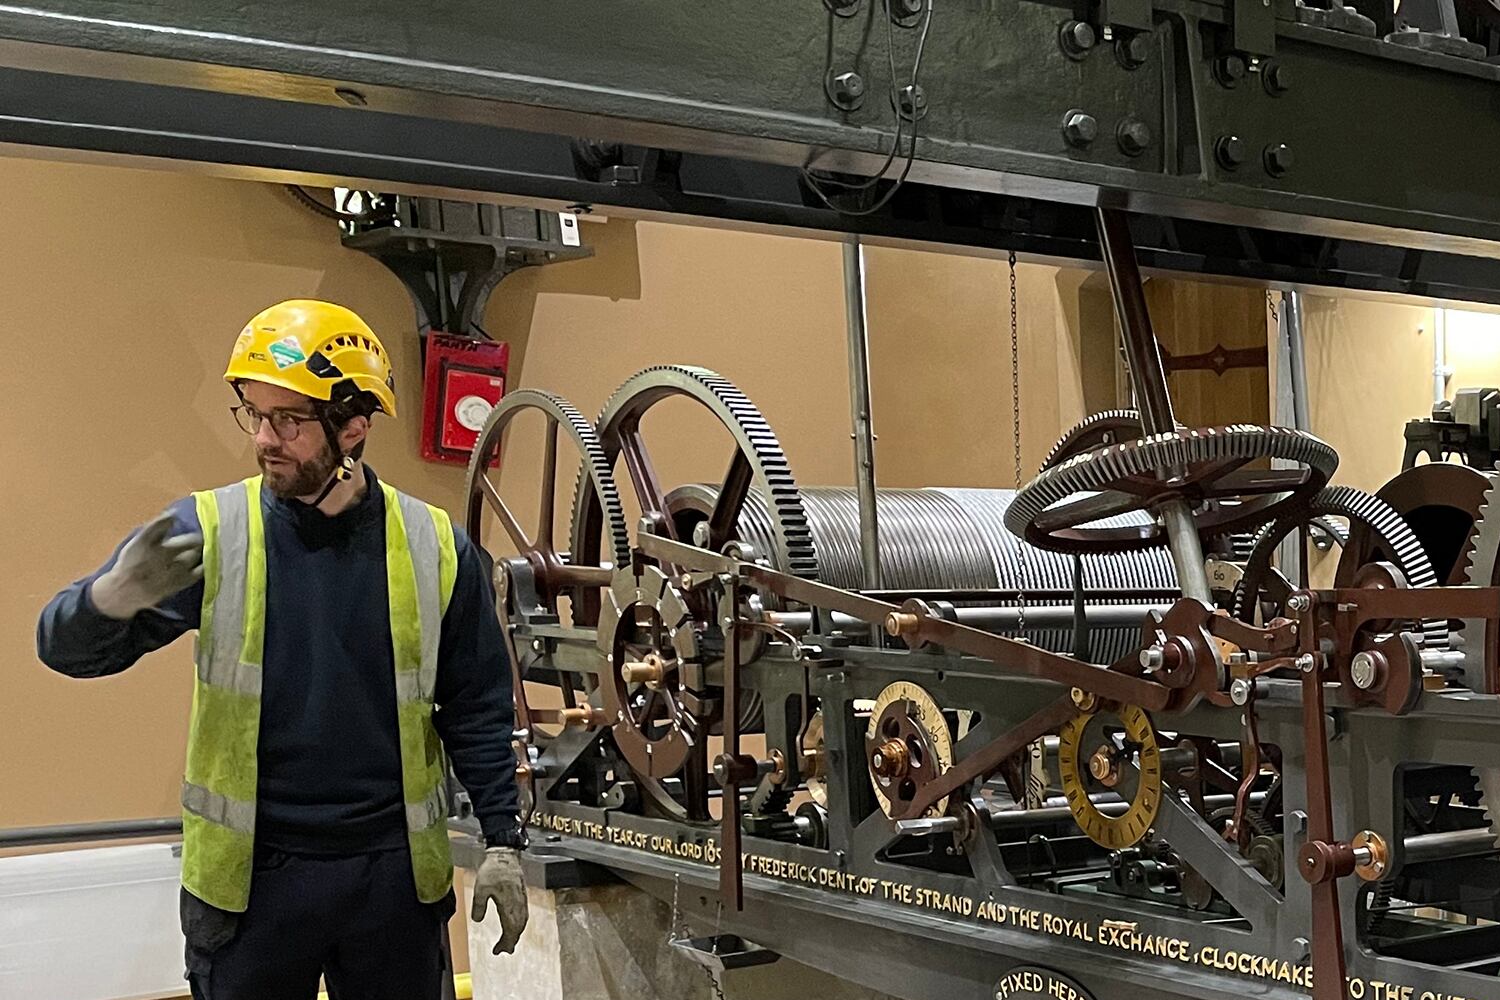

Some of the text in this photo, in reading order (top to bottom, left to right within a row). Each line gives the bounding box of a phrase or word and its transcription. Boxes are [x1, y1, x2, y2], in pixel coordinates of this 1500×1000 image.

[543, 813, 572, 832] MADE
[572, 819, 583, 835] IN
[584, 821, 604, 839] THE
[606, 826, 634, 846] YEAR
[634, 833, 648, 849] OF
[651, 835, 673, 854] OUR
[675, 842, 702, 859] LORD
[750, 855, 817, 883] FREDERICK
[859, 876, 879, 895] OF
[881, 880, 912, 904] THE
[915, 887, 973, 916] STRAND
[976, 901, 1007, 923] AND
[1008, 906, 1041, 931] THE
[1043, 913, 1093, 942] ROYAL
[1200, 946, 1314, 988] CLOCKMAKE
[1345, 976, 1365, 999] O
[1000, 971, 1043, 999] FIXED
